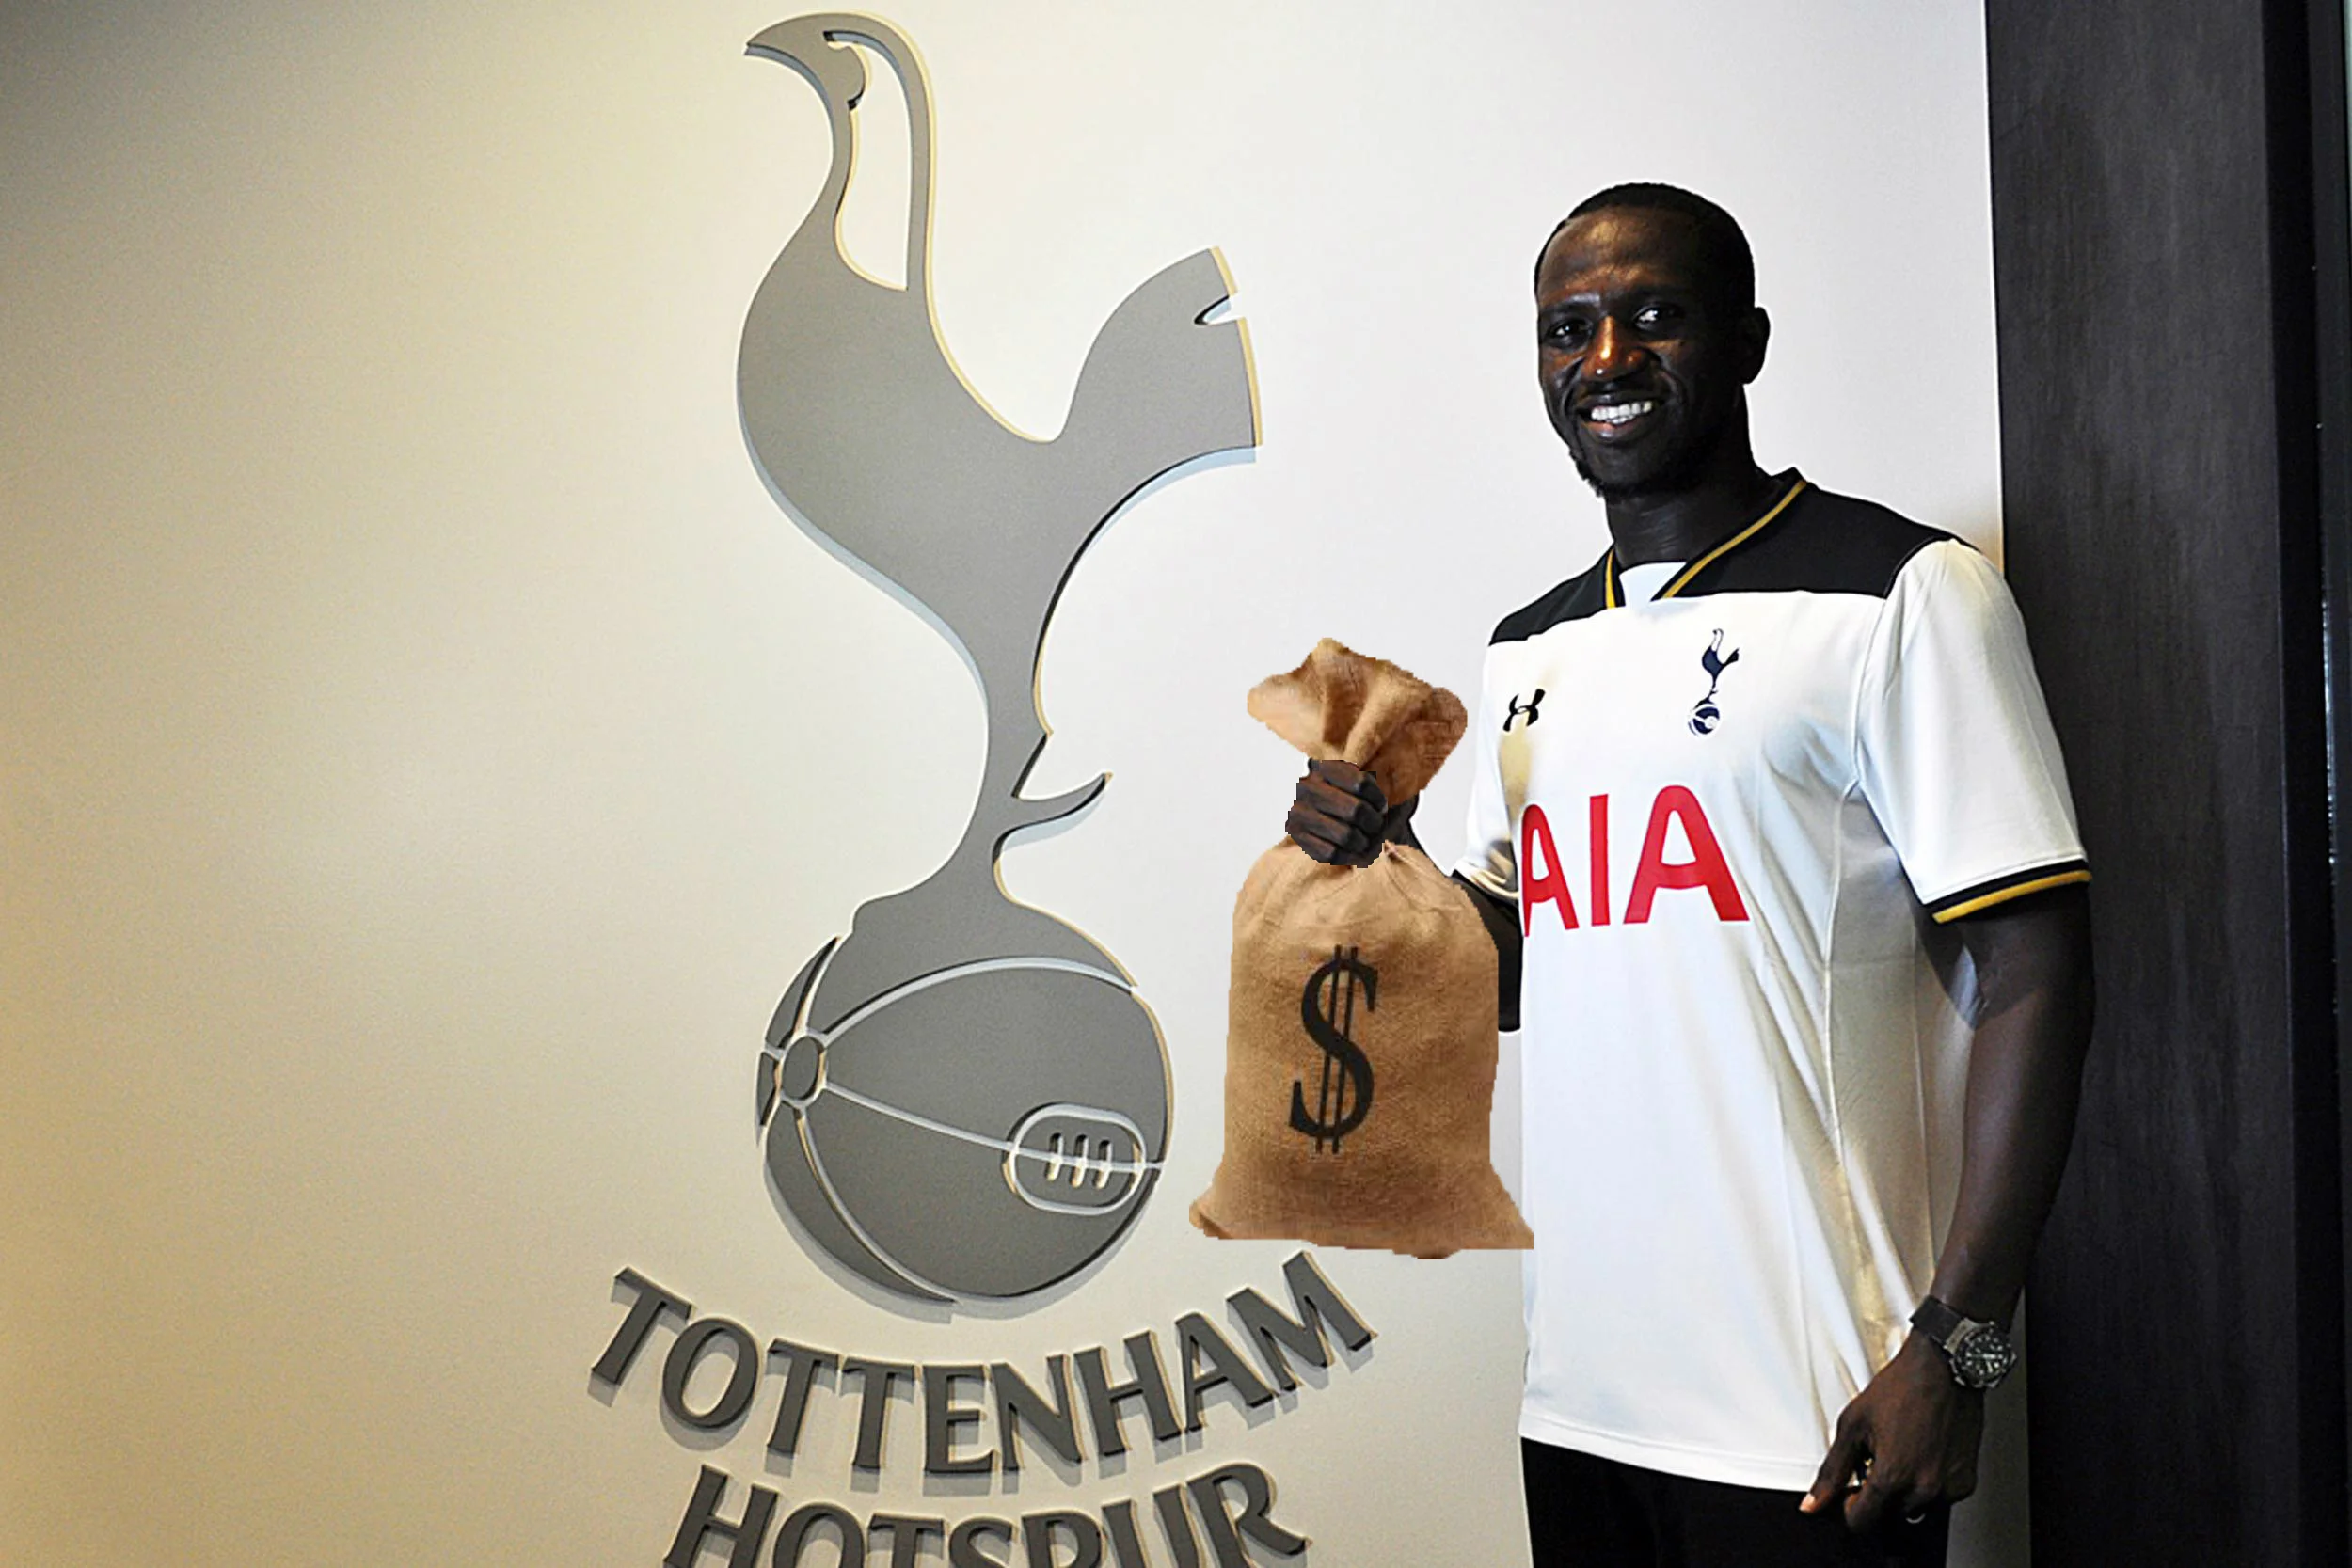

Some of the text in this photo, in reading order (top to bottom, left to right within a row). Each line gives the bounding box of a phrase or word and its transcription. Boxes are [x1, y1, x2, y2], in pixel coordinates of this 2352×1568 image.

[1521, 784, 1750, 937] AIA
[1289, 944, 1379, 1155] $
[590, 1250, 1375, 1474] TOTTENHAM
